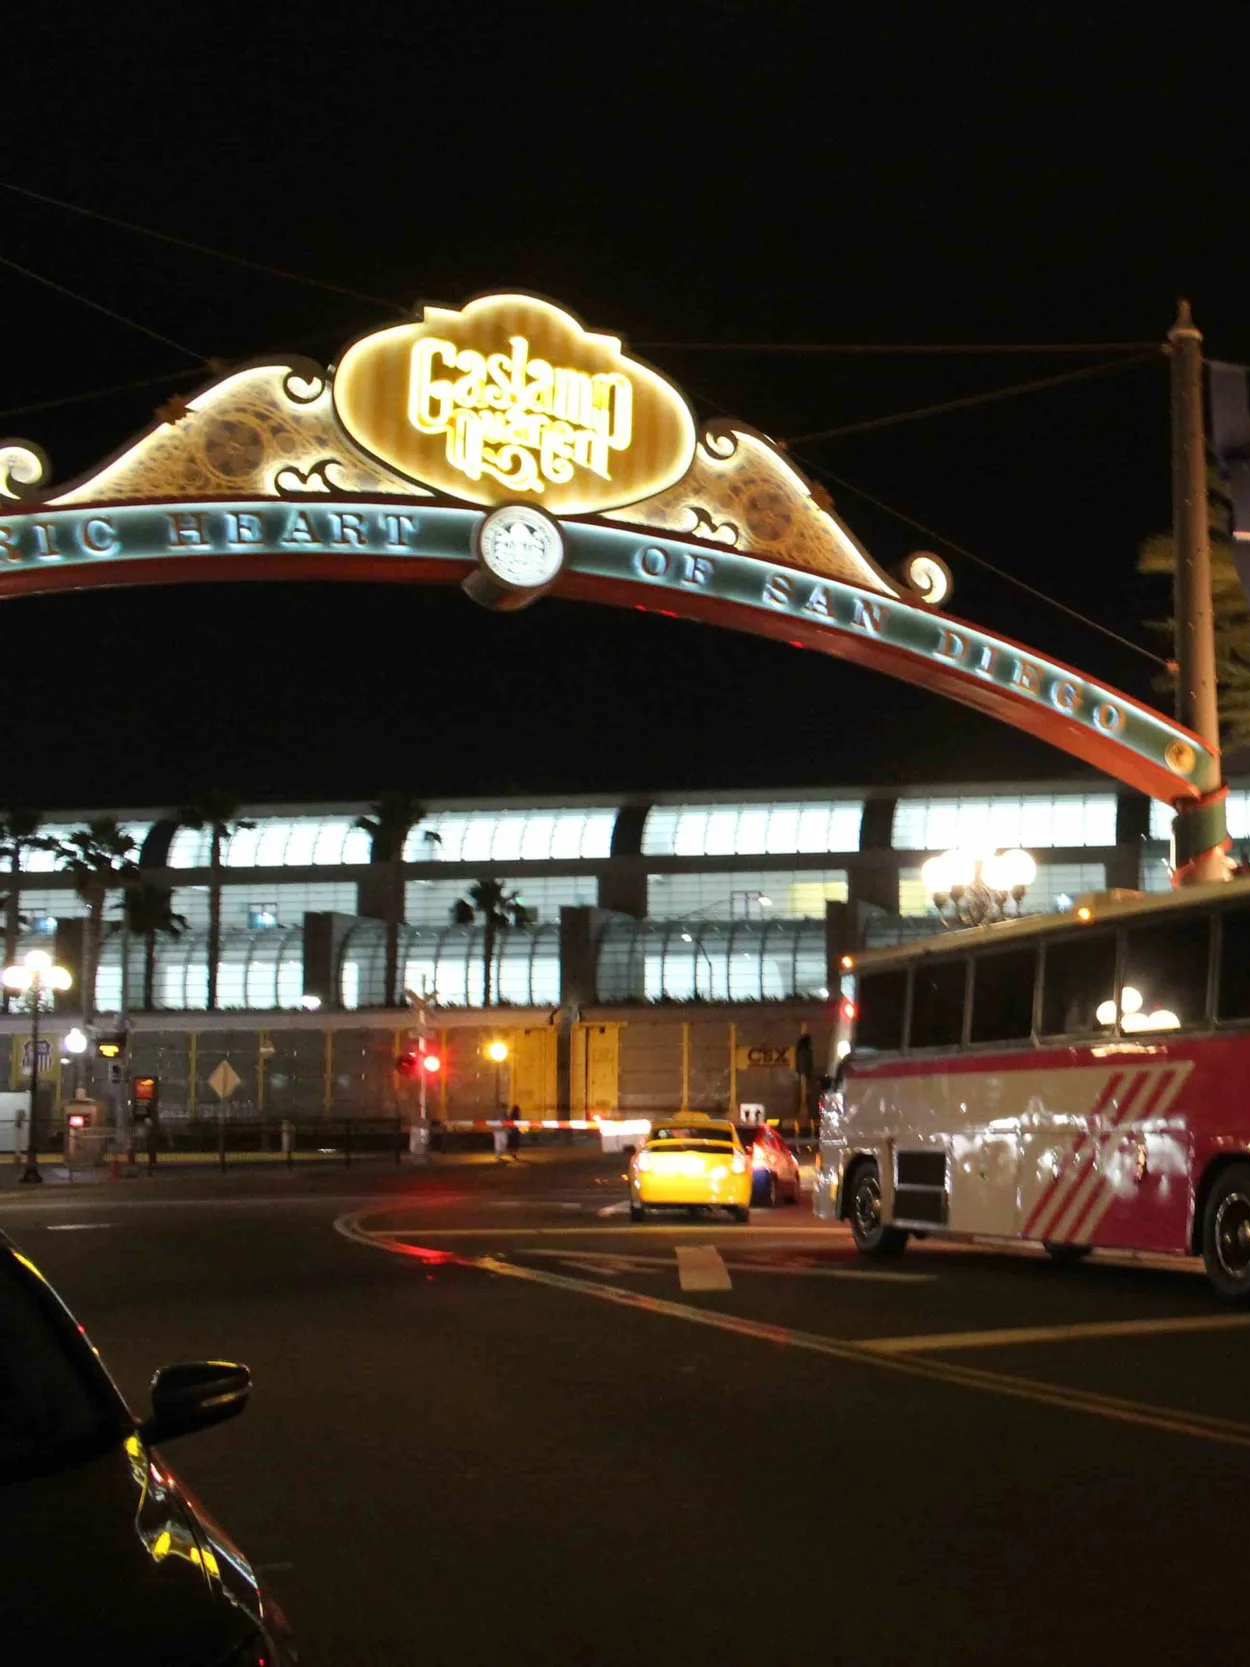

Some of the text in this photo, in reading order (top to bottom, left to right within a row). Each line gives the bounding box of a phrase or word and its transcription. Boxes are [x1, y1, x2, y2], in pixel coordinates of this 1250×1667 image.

[409, 336, 632, 450] Gaslamp
[446, 409, 611, 493] Quarter
[165, 510, 418, 548] HEART
[634, 545, 714, 587] OF
[762, 574, 887, 634] SAN
[933, 628, 1126, 732] DIEGO
